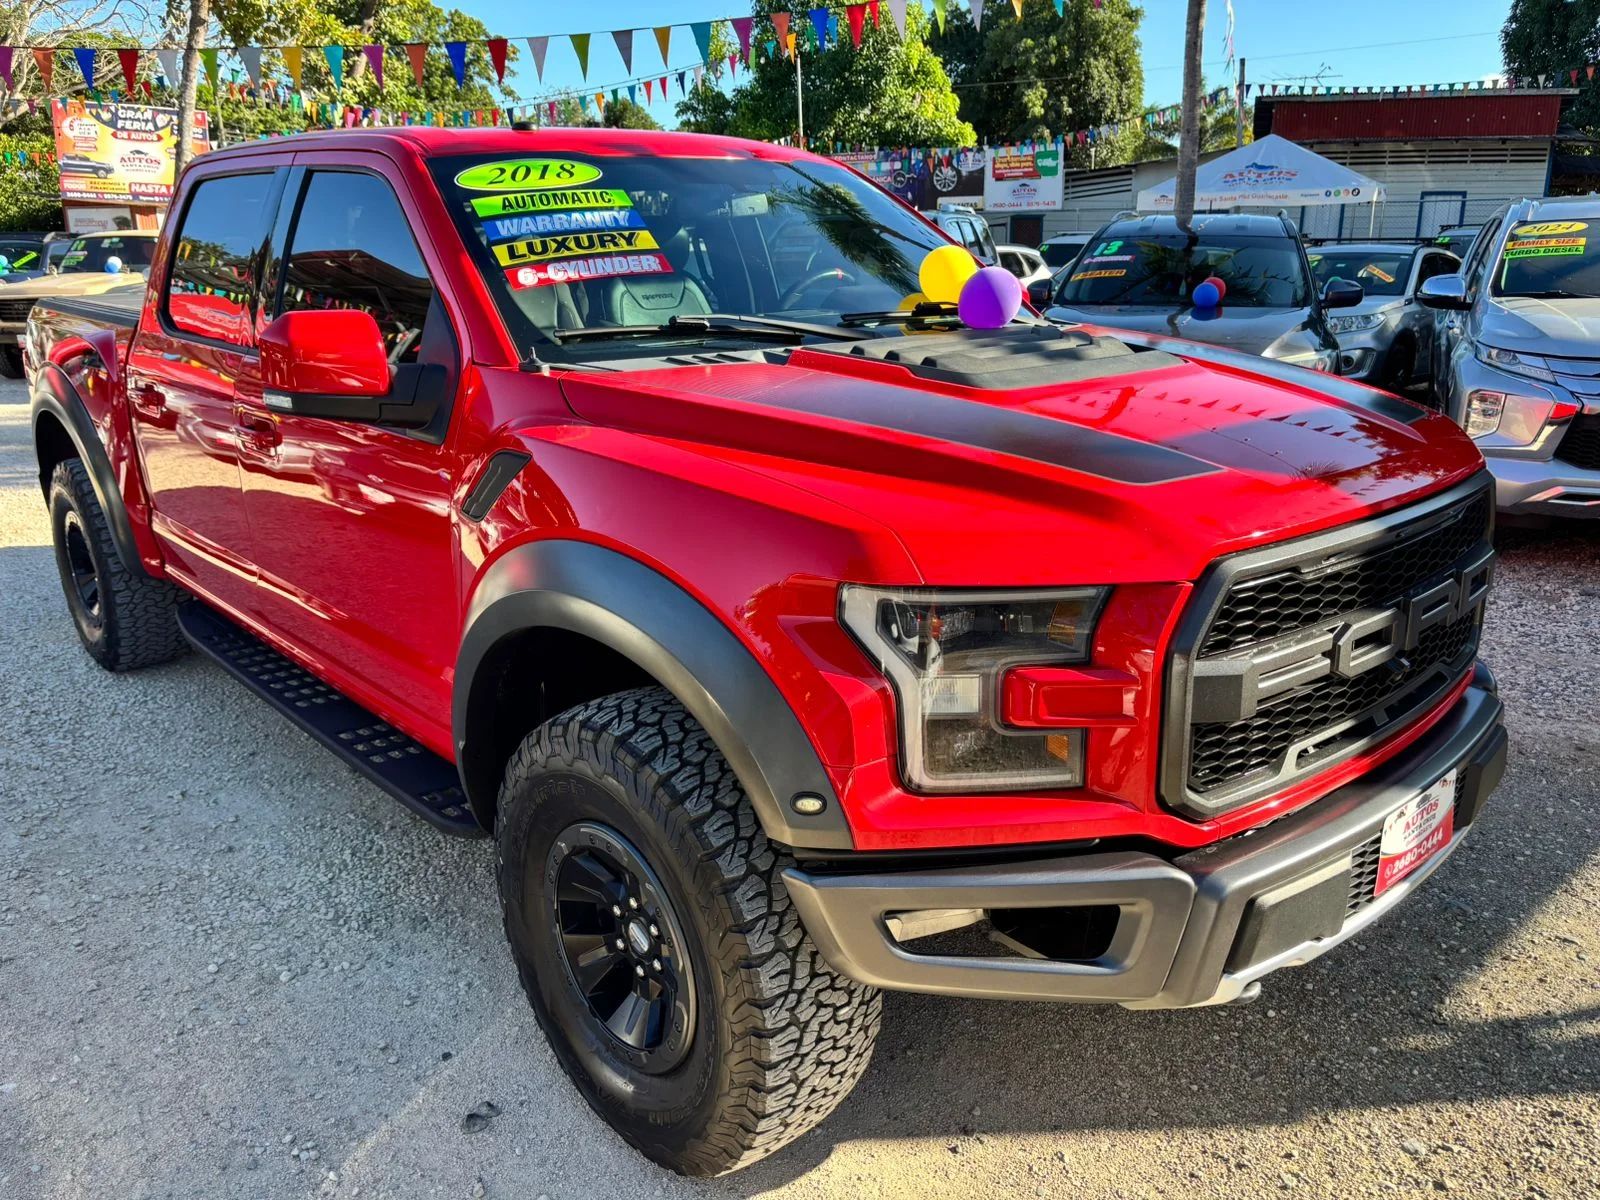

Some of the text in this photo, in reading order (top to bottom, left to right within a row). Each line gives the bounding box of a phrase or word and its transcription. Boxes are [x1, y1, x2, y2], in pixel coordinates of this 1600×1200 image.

[117, 109, 153, 120] GRAN
[117, 119, 155, 131] FERIA
[116, 131, 158, 140] DE AUTOS
[120, 156, 160, 165] AUTOS
[487, 162, 576, 185] 2018
[1223, 170, 1298, 180] AUTOS
[131, 182, 168, 193] HASTA
[502, 190, 613, 211] AUTOMATIC
[496, 211, 630, 236] WARRANTY
[1524, 222, 1577, 233] 2024
[507, 232, 638, 262] LUXURY
[1093, 240, 1124, 255] 13
[1512, 240, 1552, 248] FAMILY
[1505, 246, 1581, 257] TURBO DIESEL
[517, 255, 662, 286] 6-CYLINDER
[1240, 550, 1495, 720] FORD
[1404, 799, 1440, 834] AUTOS
[1391, 828, 1444, 875] 2680-0444
